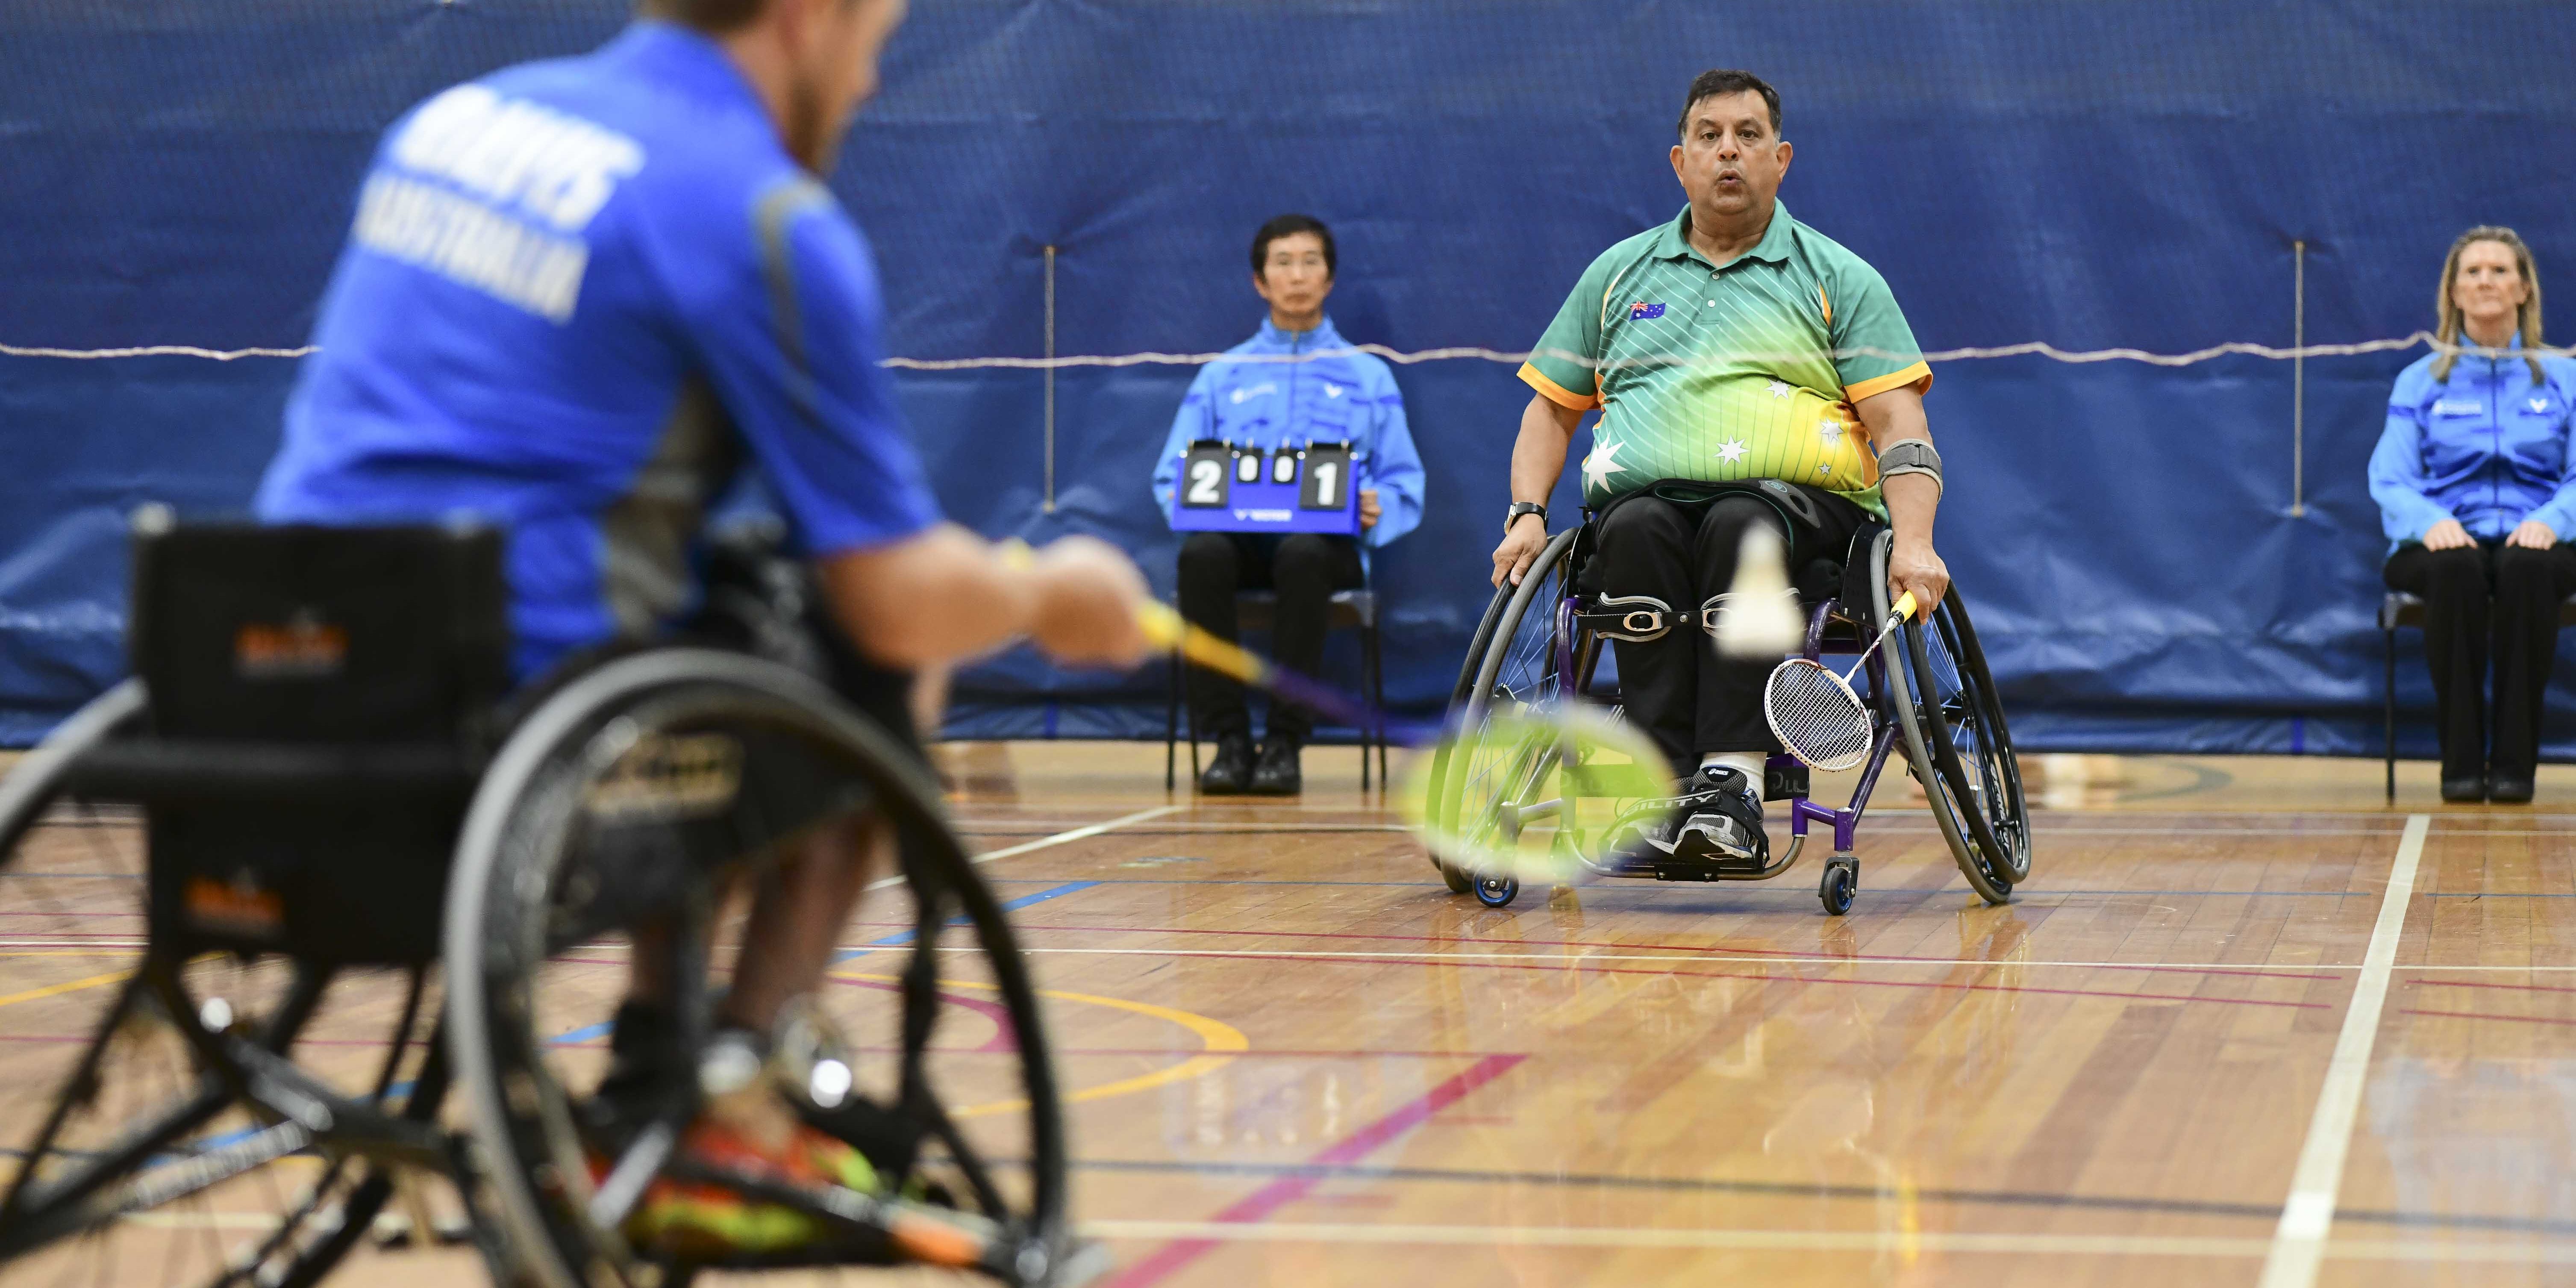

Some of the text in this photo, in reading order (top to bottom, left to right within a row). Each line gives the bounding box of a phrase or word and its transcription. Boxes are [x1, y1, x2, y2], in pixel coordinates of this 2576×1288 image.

[1188, 455, 1338, 506] 2 0 0 1
